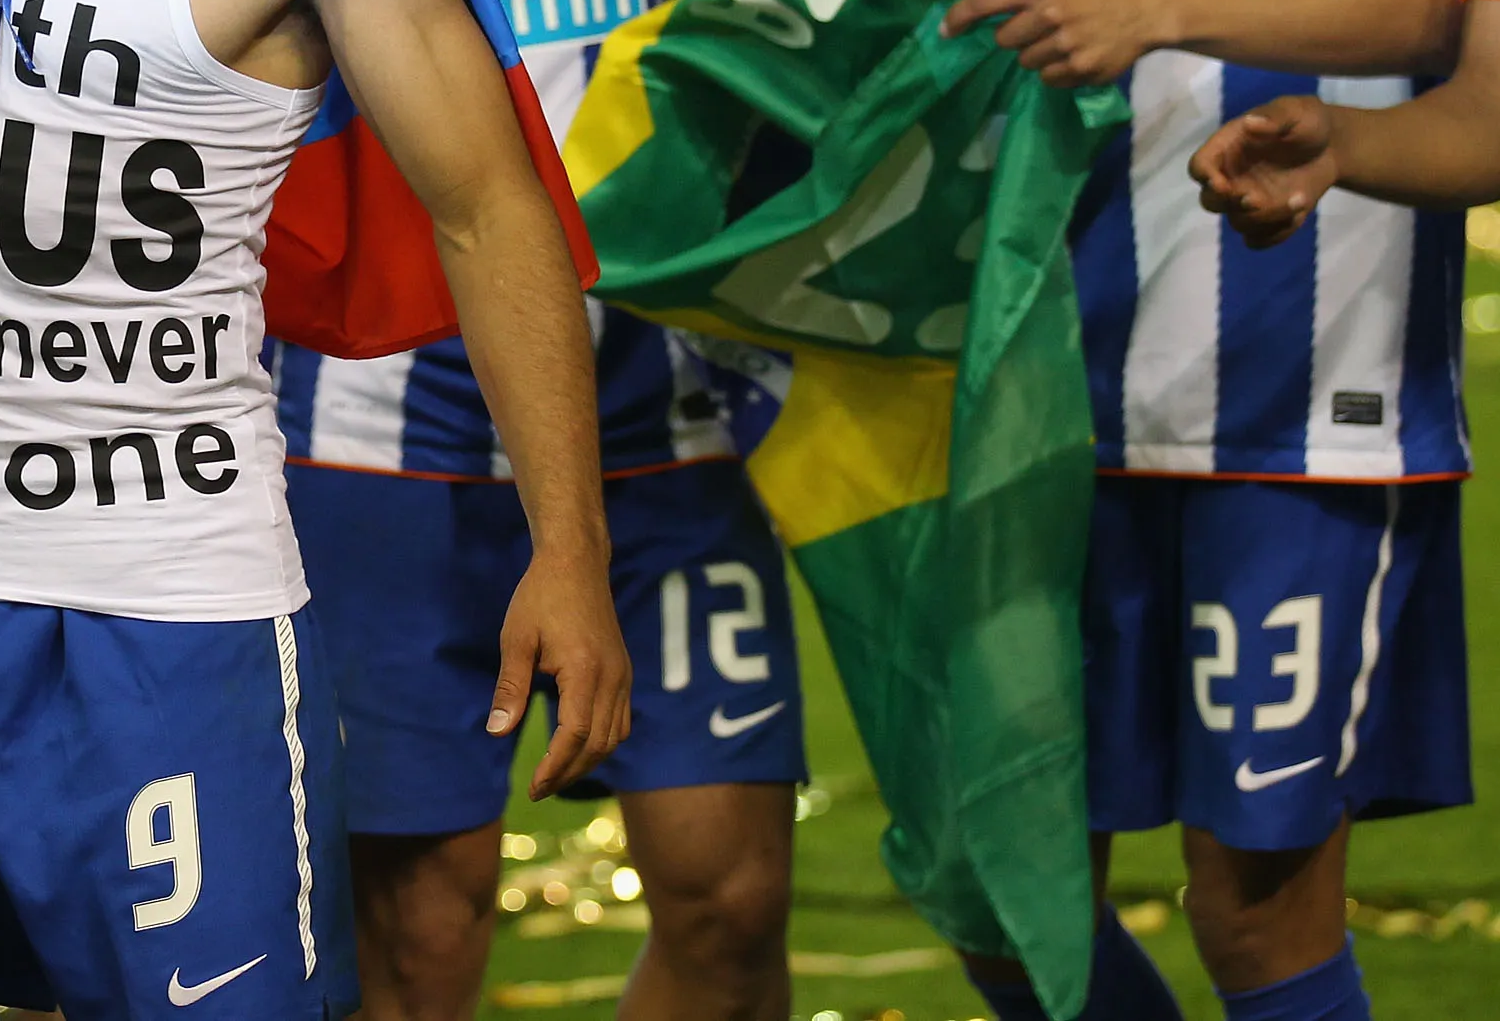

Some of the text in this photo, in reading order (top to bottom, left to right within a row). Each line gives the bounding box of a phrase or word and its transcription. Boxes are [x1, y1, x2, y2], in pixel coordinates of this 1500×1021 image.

[661, 561, 771, 692] 12
[1191, 593, 1323, 733] 23
[125, 772, 202, 932] 9
